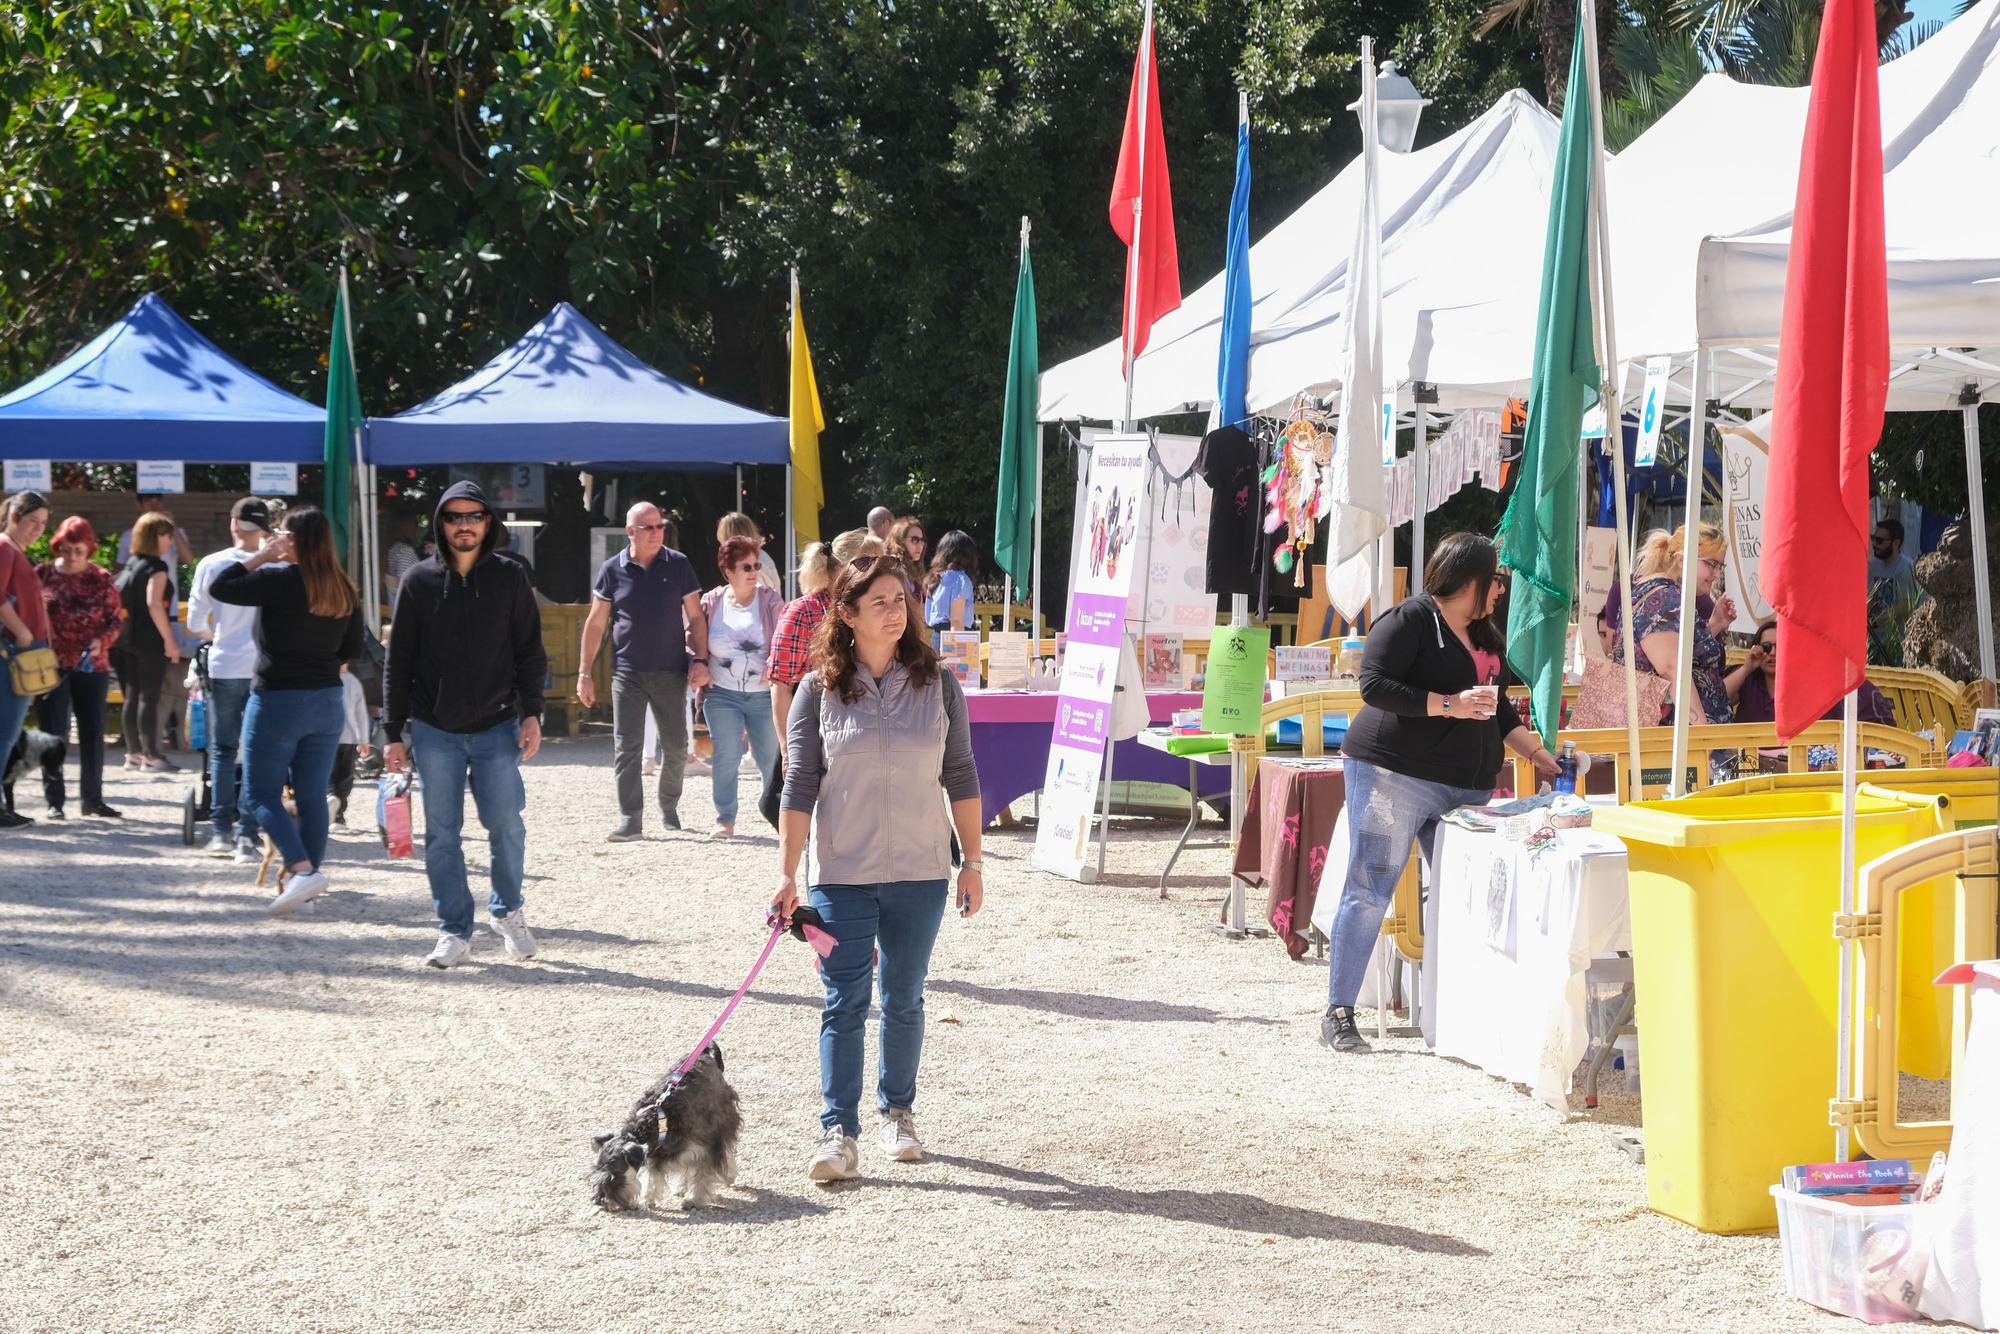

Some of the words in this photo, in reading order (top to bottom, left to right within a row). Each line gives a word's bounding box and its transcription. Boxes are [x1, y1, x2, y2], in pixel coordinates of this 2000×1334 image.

[1644, 386, 1656, 434] 6
[1383, 403, 1392, 441] 7
[1098, 452, 1121, 467] Necesitan
[1121, 455, 1128, 467] tu
[1128, 453, 1143, 470] ayuda
[517, 465, 531, 489] 3
[1152, 637, 1177, 645] Sorteo
[1284, 650, 1329, 660] TEAMING
[1285, 662, 1322, 673] REINAS
[1823, 1170, 1855, 1180] Winnie
[1857, 1169, 1873, 1179] the
[1875, 1168, 1893, 1178] Pooh
